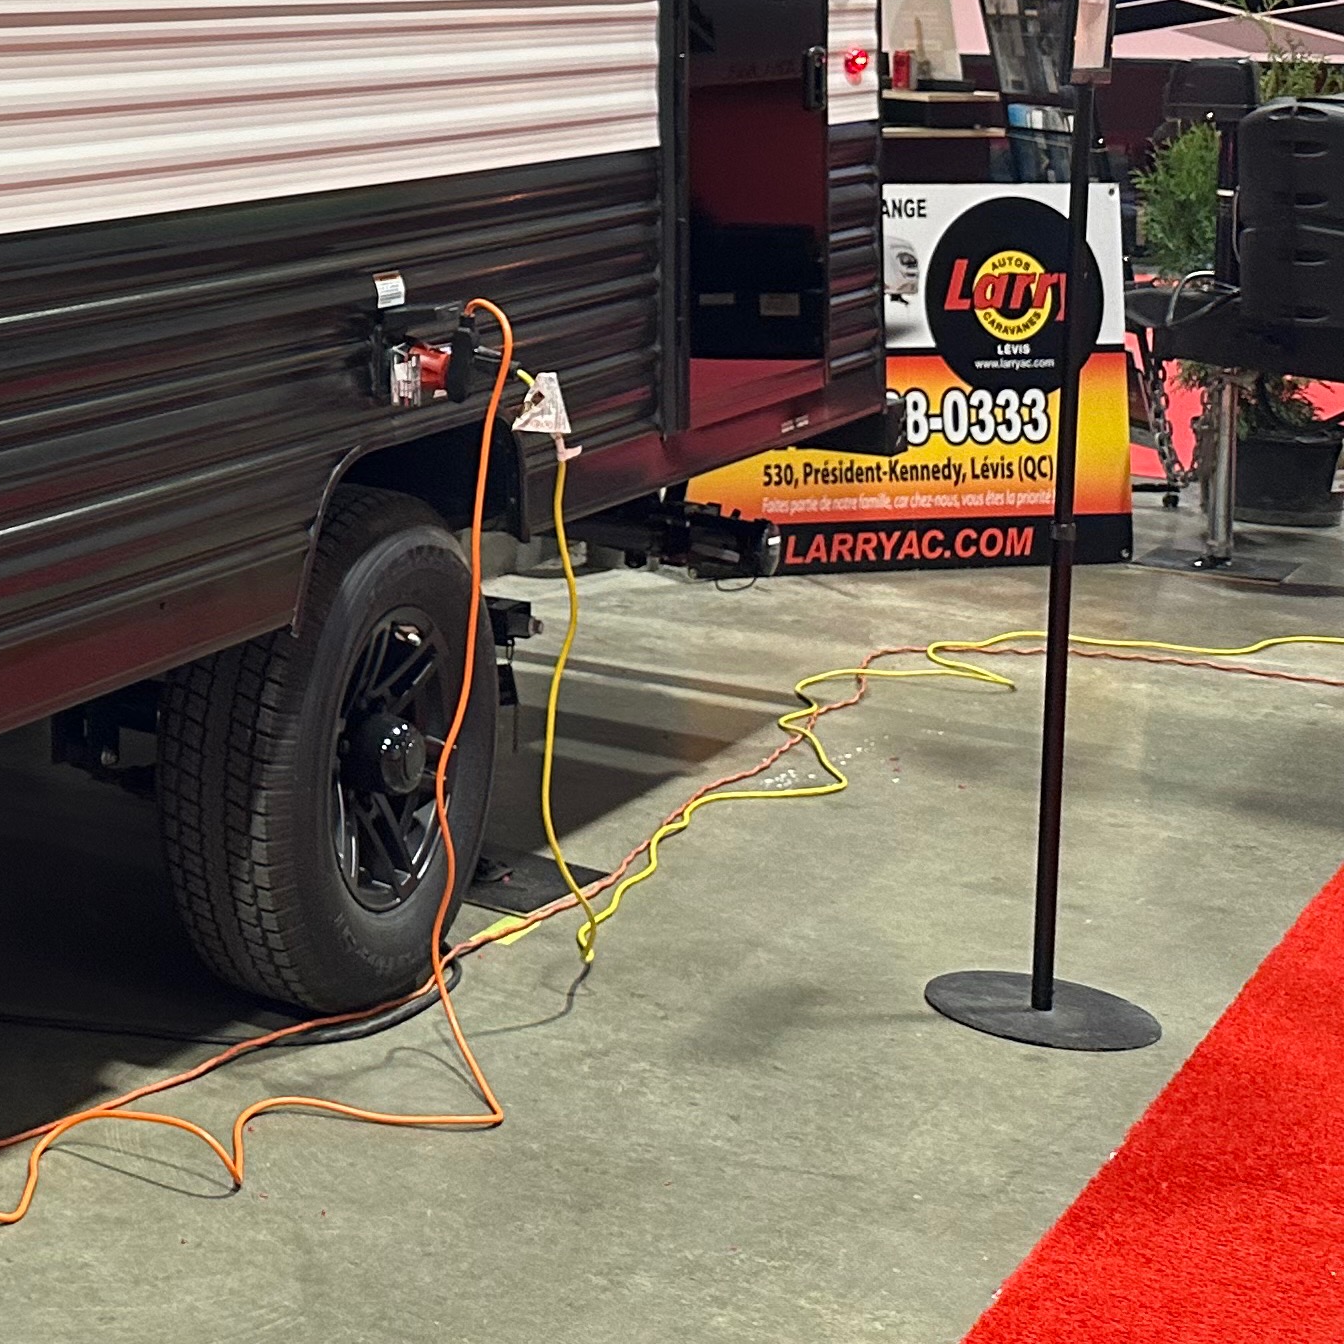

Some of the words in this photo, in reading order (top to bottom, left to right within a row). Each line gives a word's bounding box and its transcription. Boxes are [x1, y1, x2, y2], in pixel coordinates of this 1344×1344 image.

[991, 256, 1031, 272] AUTOS
[982, 311, 1042, 336] CARAVANES
[974, 357, 1055, 371] www.larryac.com
[886, 387, 1049, 445] 8-0333
[763, 463, 799, 489] 530,
[802, 457, 967, 487] Président-Kennedy,
[970, 455, 1014, 480] Lévis
[1018, 455, 1054, 482] (QC)
[961, 493, 984, 507] vous
[784, 526, 1035, 565] LARRYAC.COM
